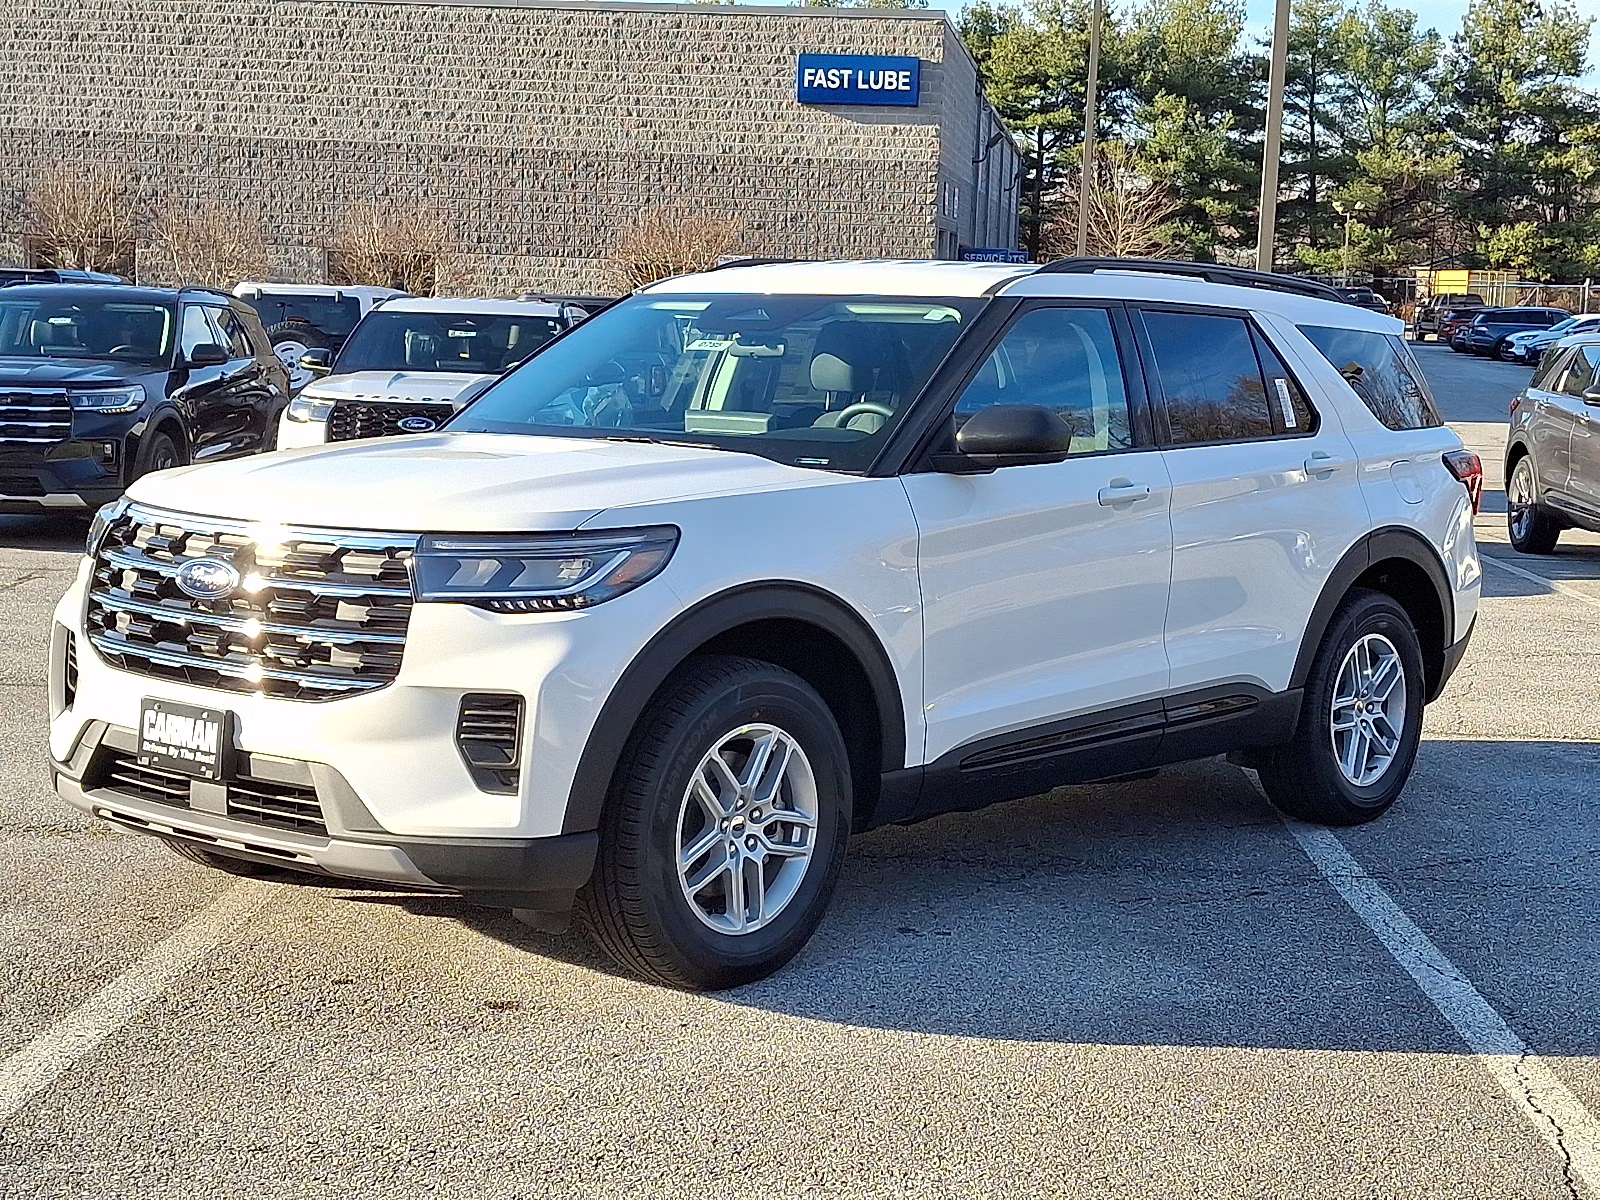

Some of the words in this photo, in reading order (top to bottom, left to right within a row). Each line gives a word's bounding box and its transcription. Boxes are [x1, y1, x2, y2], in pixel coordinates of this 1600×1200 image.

[803, 68, 853, 89] FAST
[857, 69, 911, 91] LUBE
[963, 253, 1005, 263] SERVICE
[143, 709, 219, 754] CARMAN
[168, 745, 180, 759] By
[180, 748, 195, 761] The
